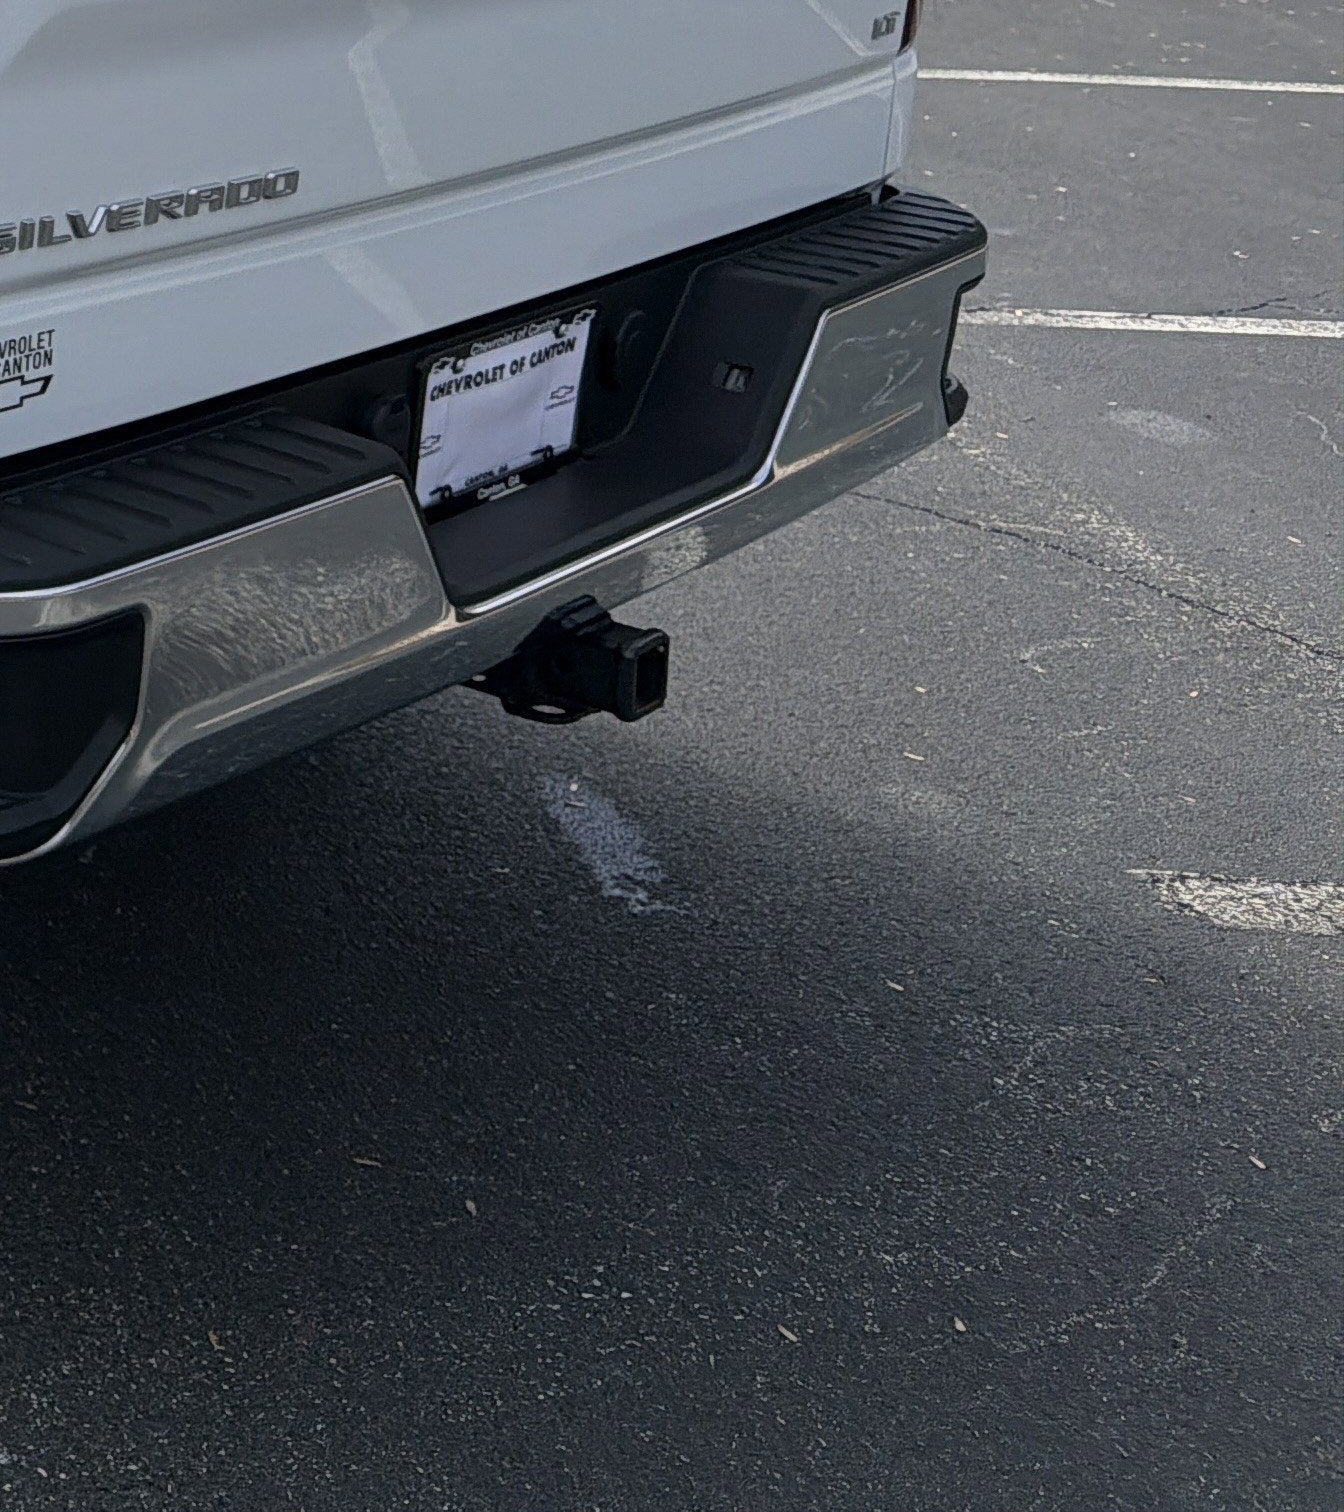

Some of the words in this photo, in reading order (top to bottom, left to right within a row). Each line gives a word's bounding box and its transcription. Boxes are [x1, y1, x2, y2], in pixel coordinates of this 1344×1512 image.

[431, 365, 505, 401] CHEVROLET
[510, 356, 526, 376] OF
[530, 338, 576, 368] CANTON
